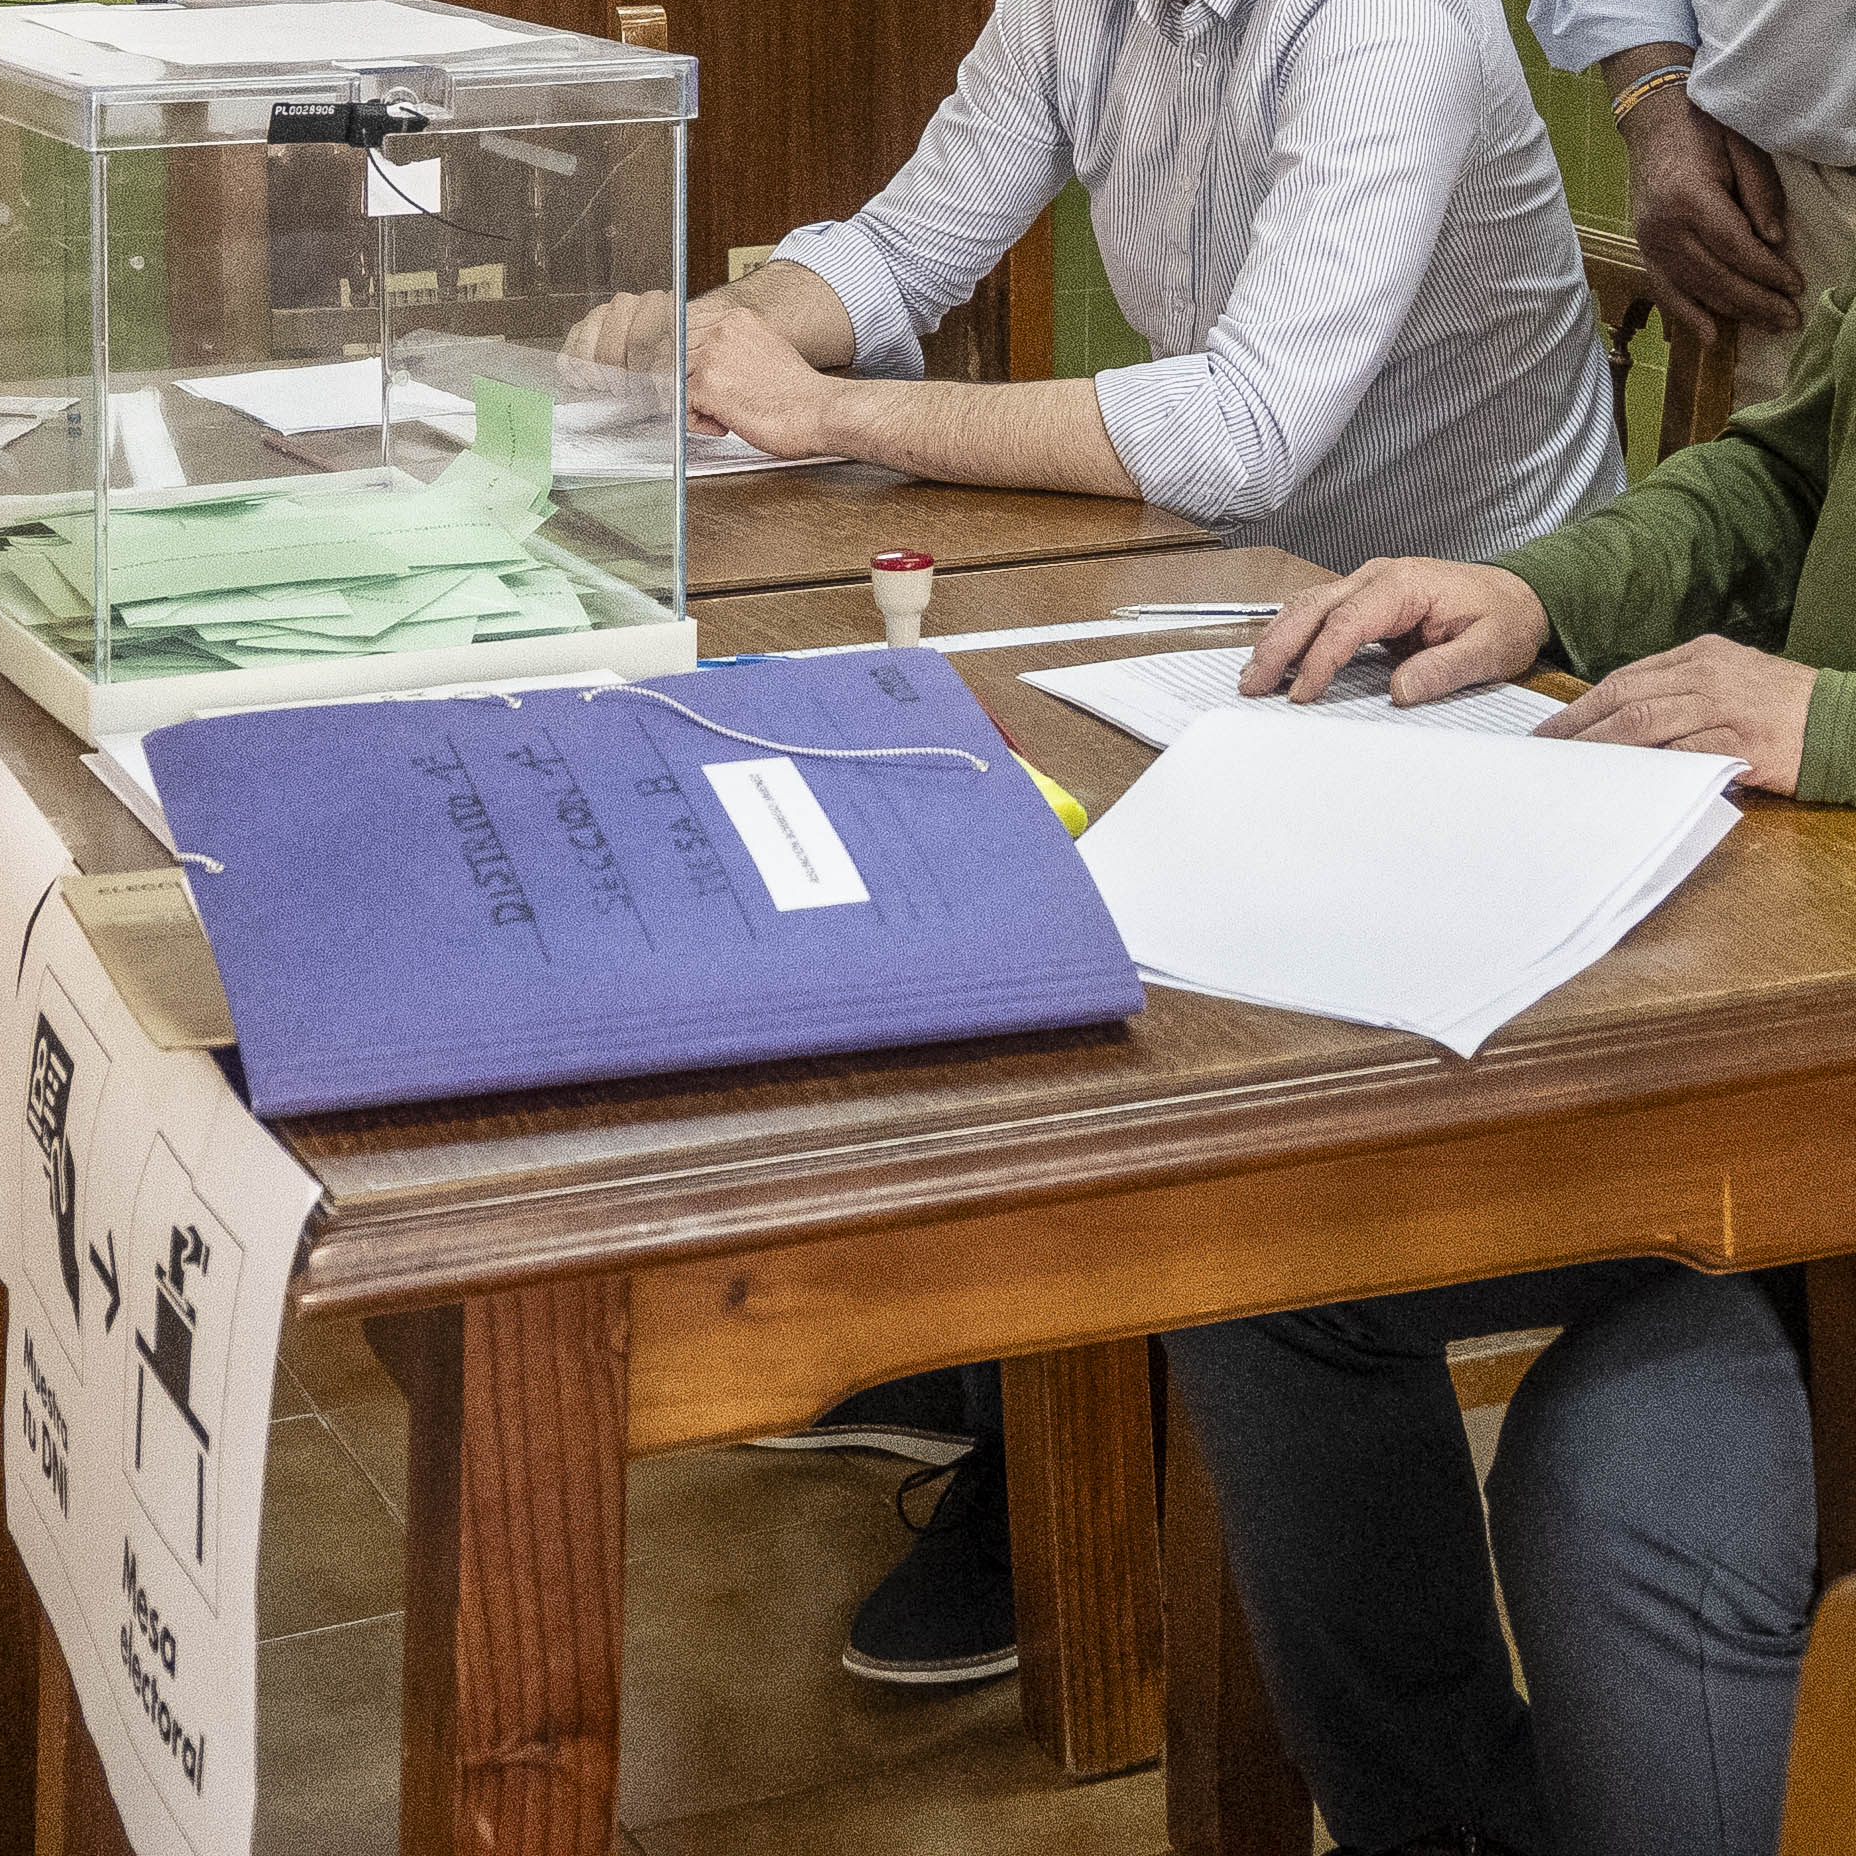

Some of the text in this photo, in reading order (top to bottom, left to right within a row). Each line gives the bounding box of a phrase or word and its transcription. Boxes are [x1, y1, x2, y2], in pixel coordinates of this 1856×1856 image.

[633, 775, 682, 796] B
[22, 1389, 68, 1520] tu DNI
[23, 1326, 68, 1456] Muestra
[122, 1535, 176, 1680] Mesa
[120, 1618, 204, 1796] electoral
